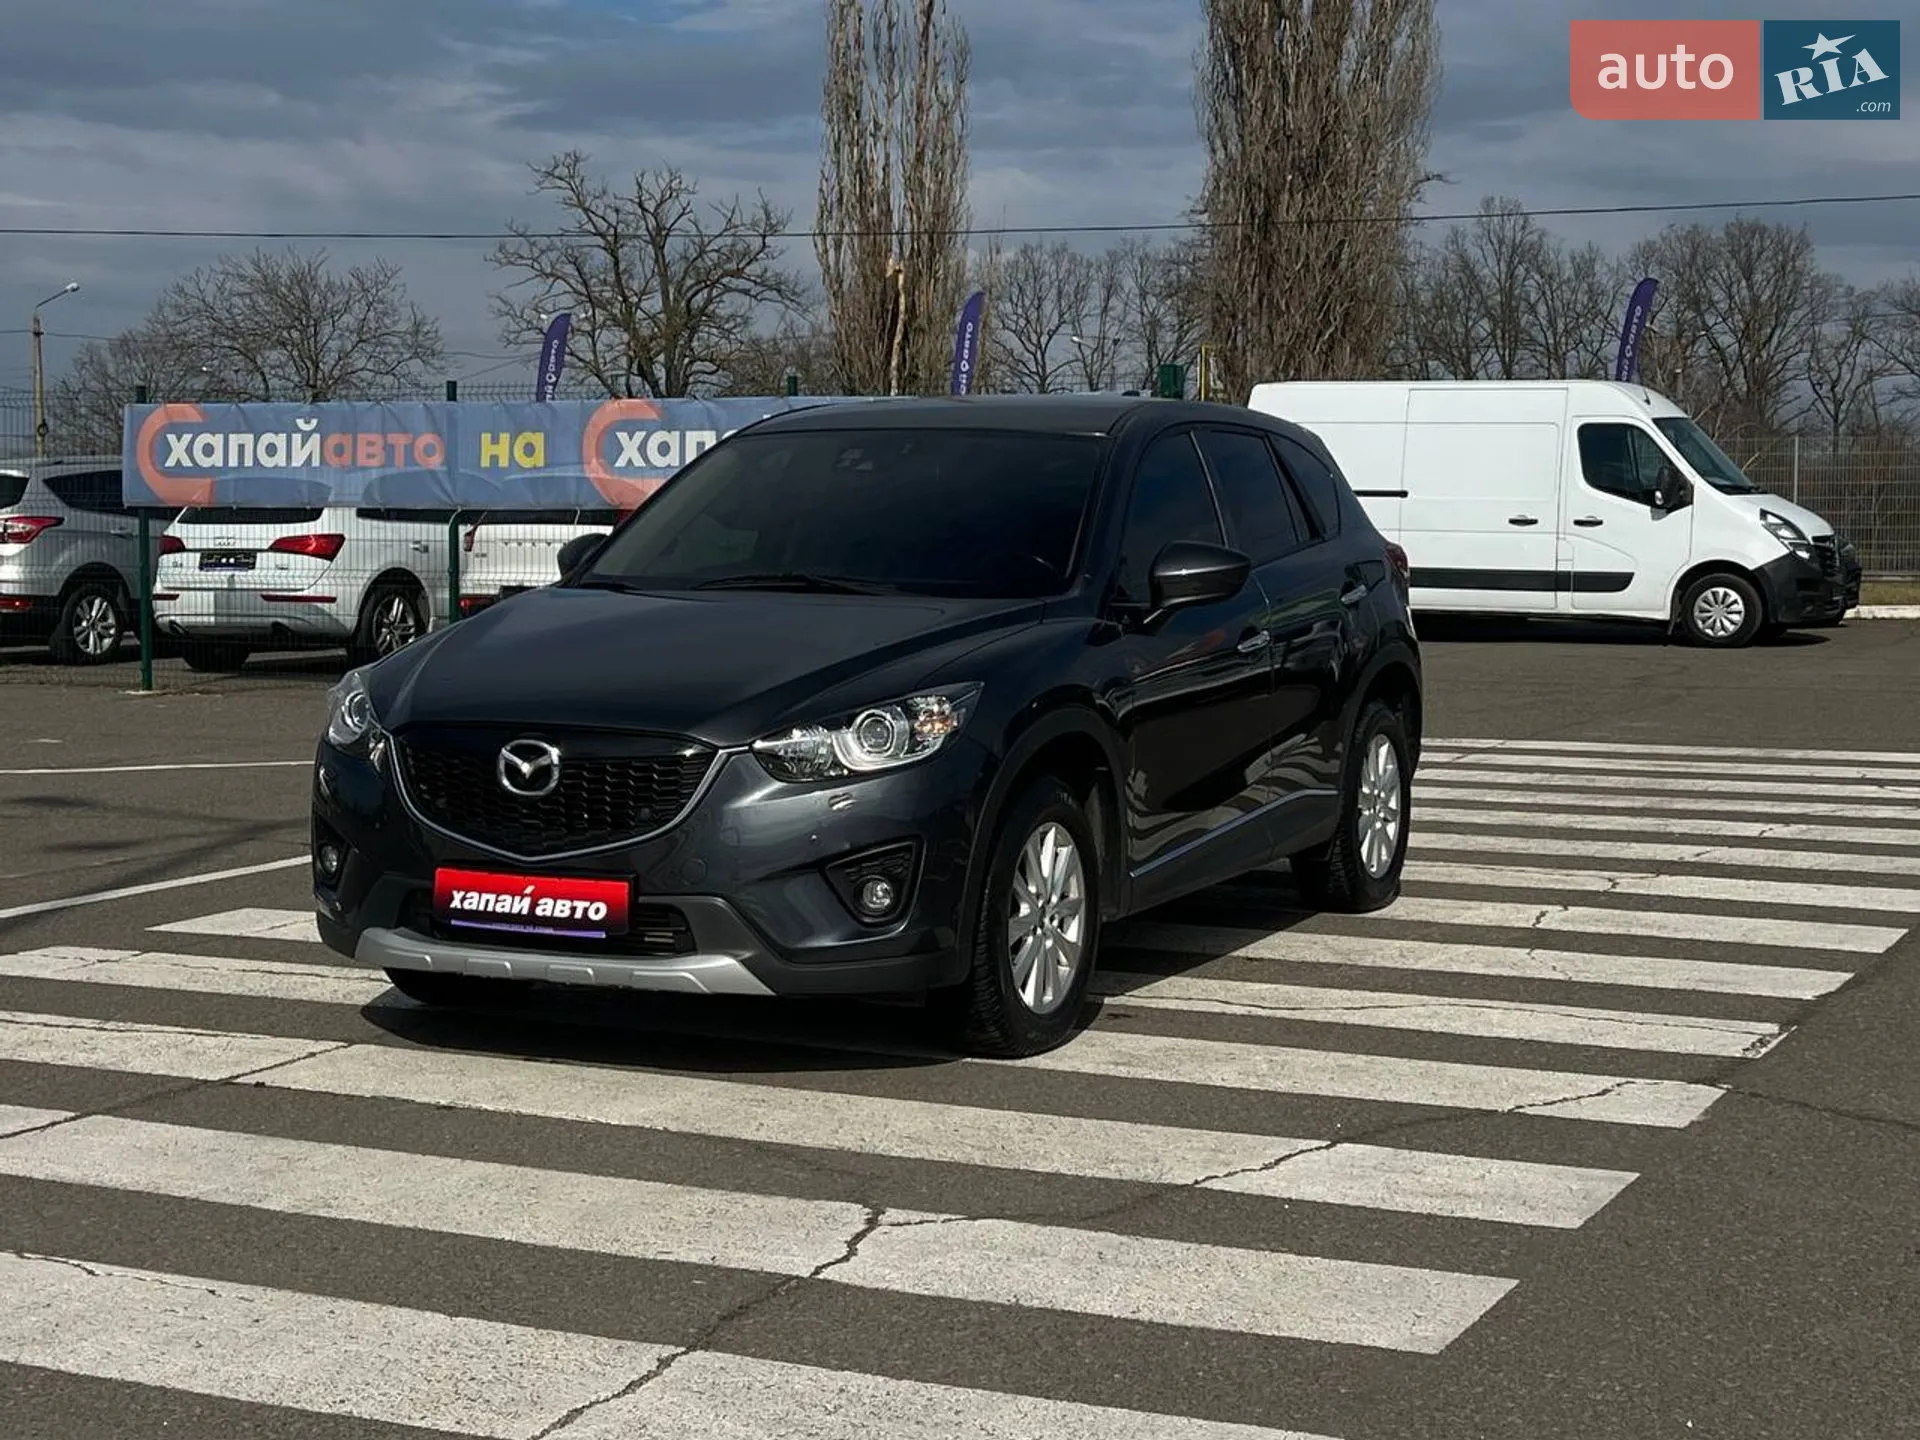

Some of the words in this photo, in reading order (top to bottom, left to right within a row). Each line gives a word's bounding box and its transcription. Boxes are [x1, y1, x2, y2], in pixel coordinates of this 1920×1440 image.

[480, 432, 544, 467] на
[614, 429, 740, 467] хап
[535, 897, 608, 921] авто
